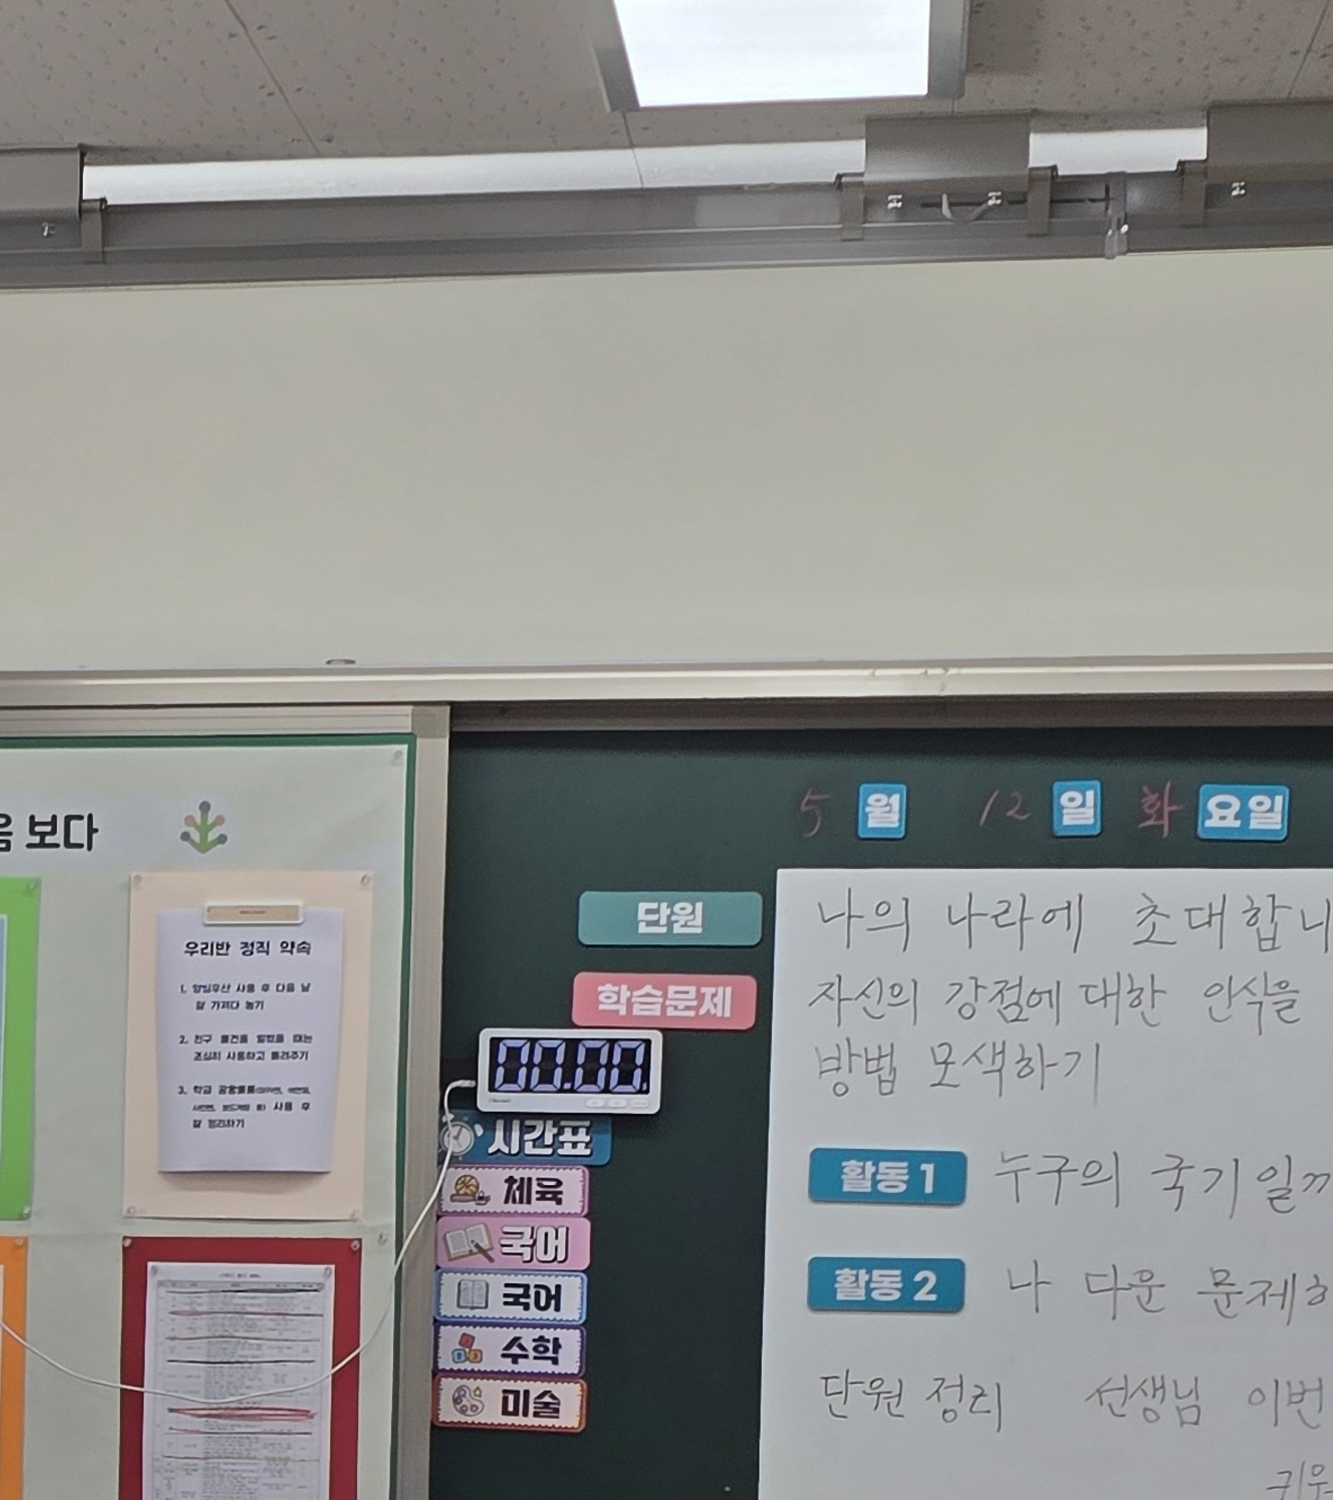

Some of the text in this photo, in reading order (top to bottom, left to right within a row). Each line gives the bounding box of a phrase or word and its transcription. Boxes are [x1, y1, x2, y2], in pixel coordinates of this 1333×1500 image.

[799, 788, 831, 837] 5
[865, 792, 900, 828] 월
[979, 788, 1031, 827] 12
[1059, 790, 1096, 826] 일
[1138, 781, 1183, 837] 화
[1204, 794, 1283, 830] 요일
[26, 813, 99, 853] 보다
[637, 901, 704, 934] 단원
[817, 887, 910, 952] 나의
[947, 890, 1084, 953] 나라에
[184, 941, 312, 957] 우리반 정직 약속
[211, 1000, 239, 1010] 가져다
[236, 983, 255, 993] 사용
[261, 983, 270, 993] 후
[276, 983, 294, 993] 다음
[597, 984, 732, 1018] 학습문제
[808, 970, 1301, 1036] 자신의 강점에 대한 인식을
[194, 1035, 212, 1044] 친구
[226, 1051, 265, 1061] 사용하고
[815, 1037, 1101, 1109] 방법 모색하기
[274, 1101, 293, 1111] 사용
[488, 1119, 591, 1156] 시간표
[503, 1176, 564, 1206] 체육
[841, 1161, 935, 1194] 활동 1
[995, 1151, 1120, 1208] 누구의
[500, 1227, 569, 1263] 국어
[502, 1284, 562, 1312] 국어
[834, 1269, 937, 1302] 활동 2
[1008, 1260, 1052, 1314] 나
[1085, 1263, 1165, 1320] 다운
[500, 1336, 562, 1366] 수학
[501, 1389, 561, 1419] 미술
[821, 1369, 1323, 1433] 단원 정리 선생님 이번
